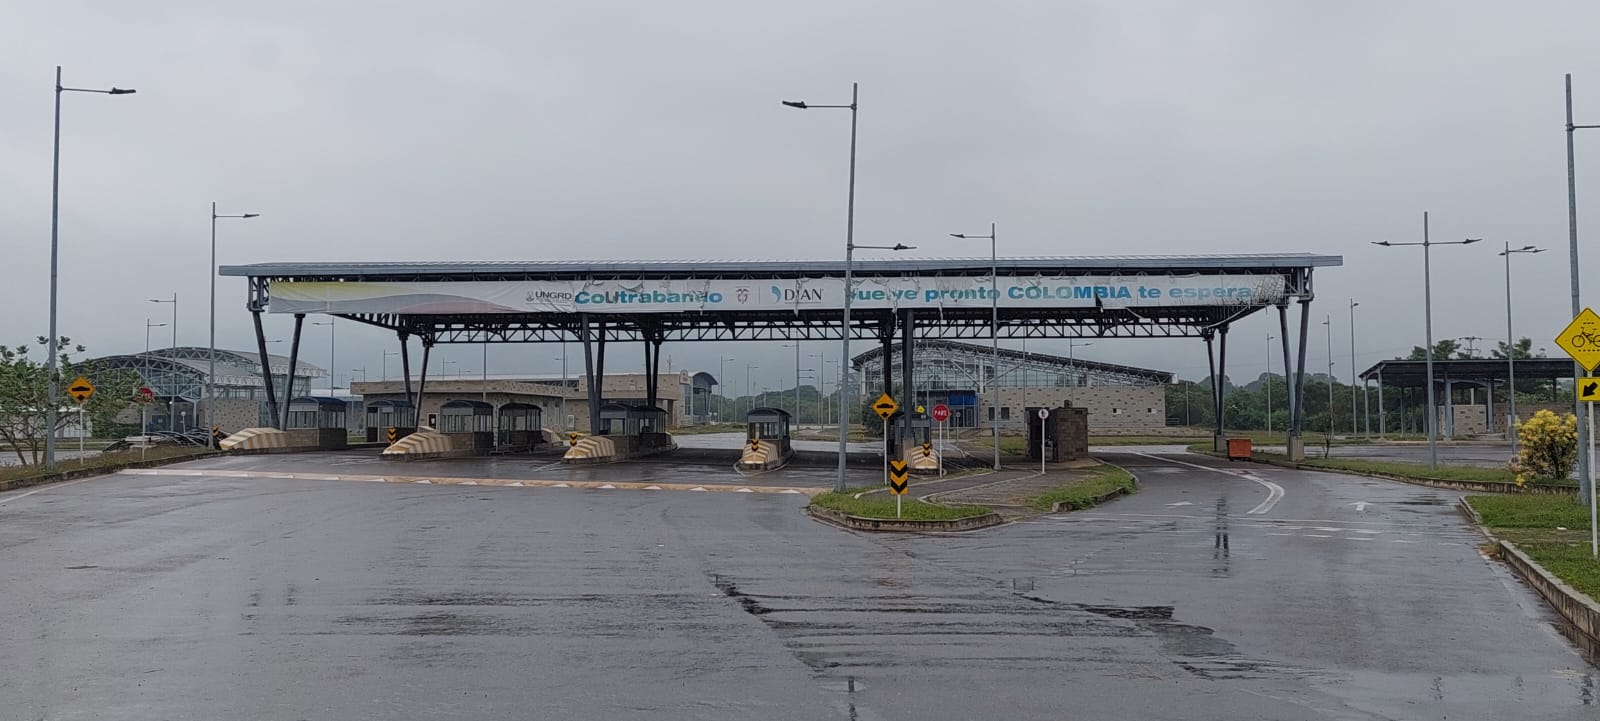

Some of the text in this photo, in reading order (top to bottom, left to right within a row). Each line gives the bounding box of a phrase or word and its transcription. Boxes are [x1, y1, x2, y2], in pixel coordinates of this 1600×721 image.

[535, 291, 572, 300] UNGRD
[848, 285, 1251, 303] ueve pronto COLOMBIA te espera
